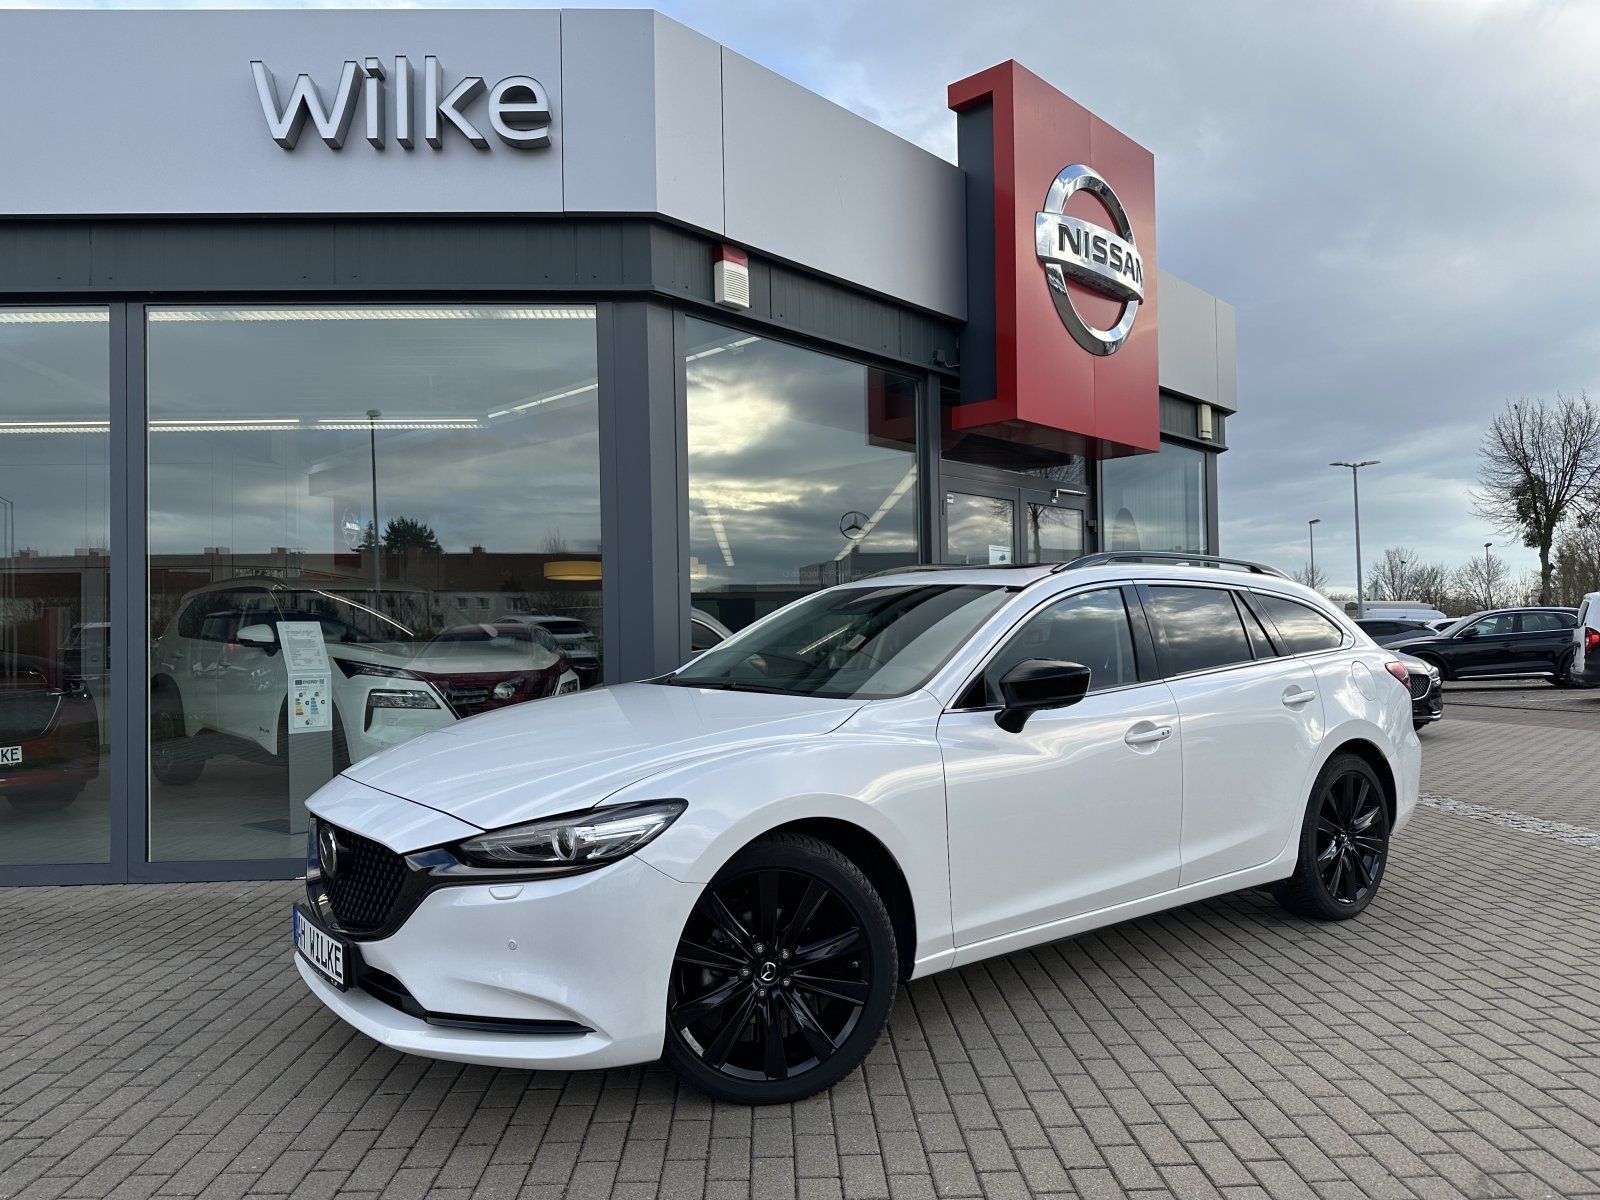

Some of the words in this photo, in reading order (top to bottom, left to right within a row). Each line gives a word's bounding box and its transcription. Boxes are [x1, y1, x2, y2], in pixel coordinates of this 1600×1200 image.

[249, 55, 552, 151] Wilke
[1058, 223, 1143, 286] NISSAN
[310, 927, 343, 979] WILKE
